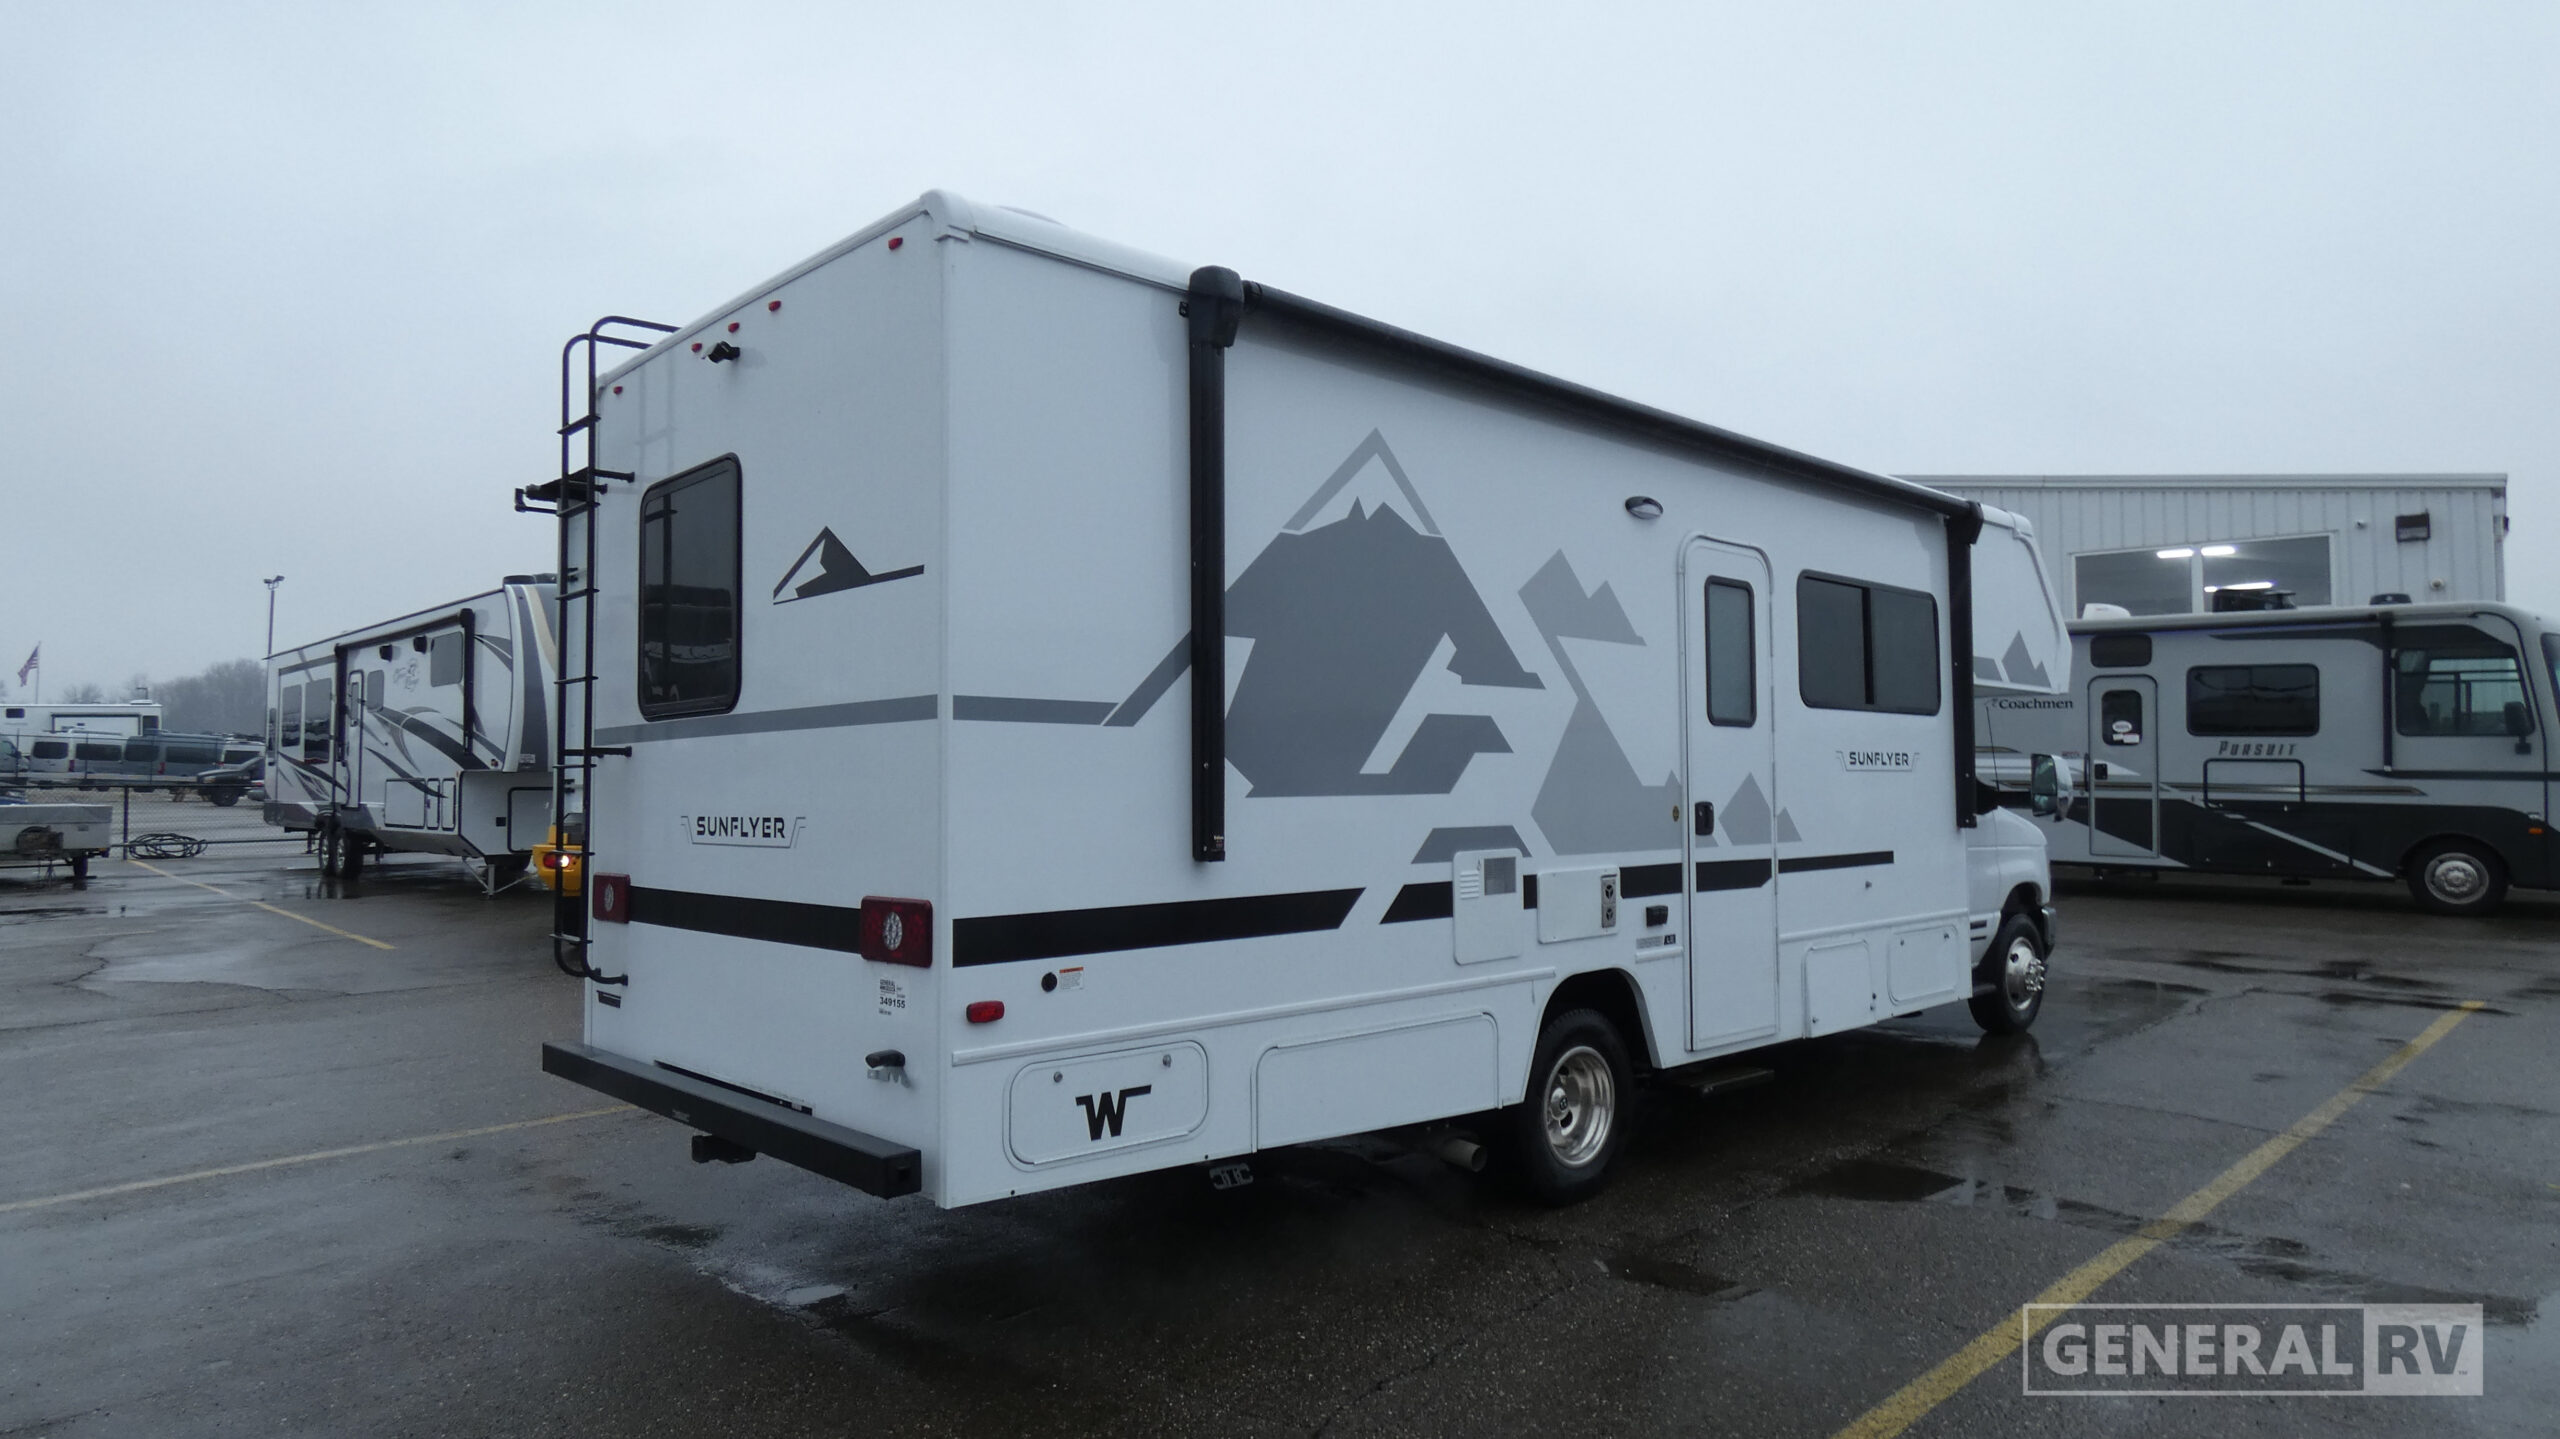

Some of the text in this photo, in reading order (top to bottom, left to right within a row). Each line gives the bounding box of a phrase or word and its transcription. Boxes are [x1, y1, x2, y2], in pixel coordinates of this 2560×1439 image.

[1999, 698, 2073, 710] Coachmen
[2219, 740, 2296, 756] PURSUIT
[1848, 751, 1910, 766] SUNFLYER
[696, 816, 785, 839] SUNFLYER
[879, 996, 906, 1009] 349155
[1075, 1084, 1152, 1142] W
